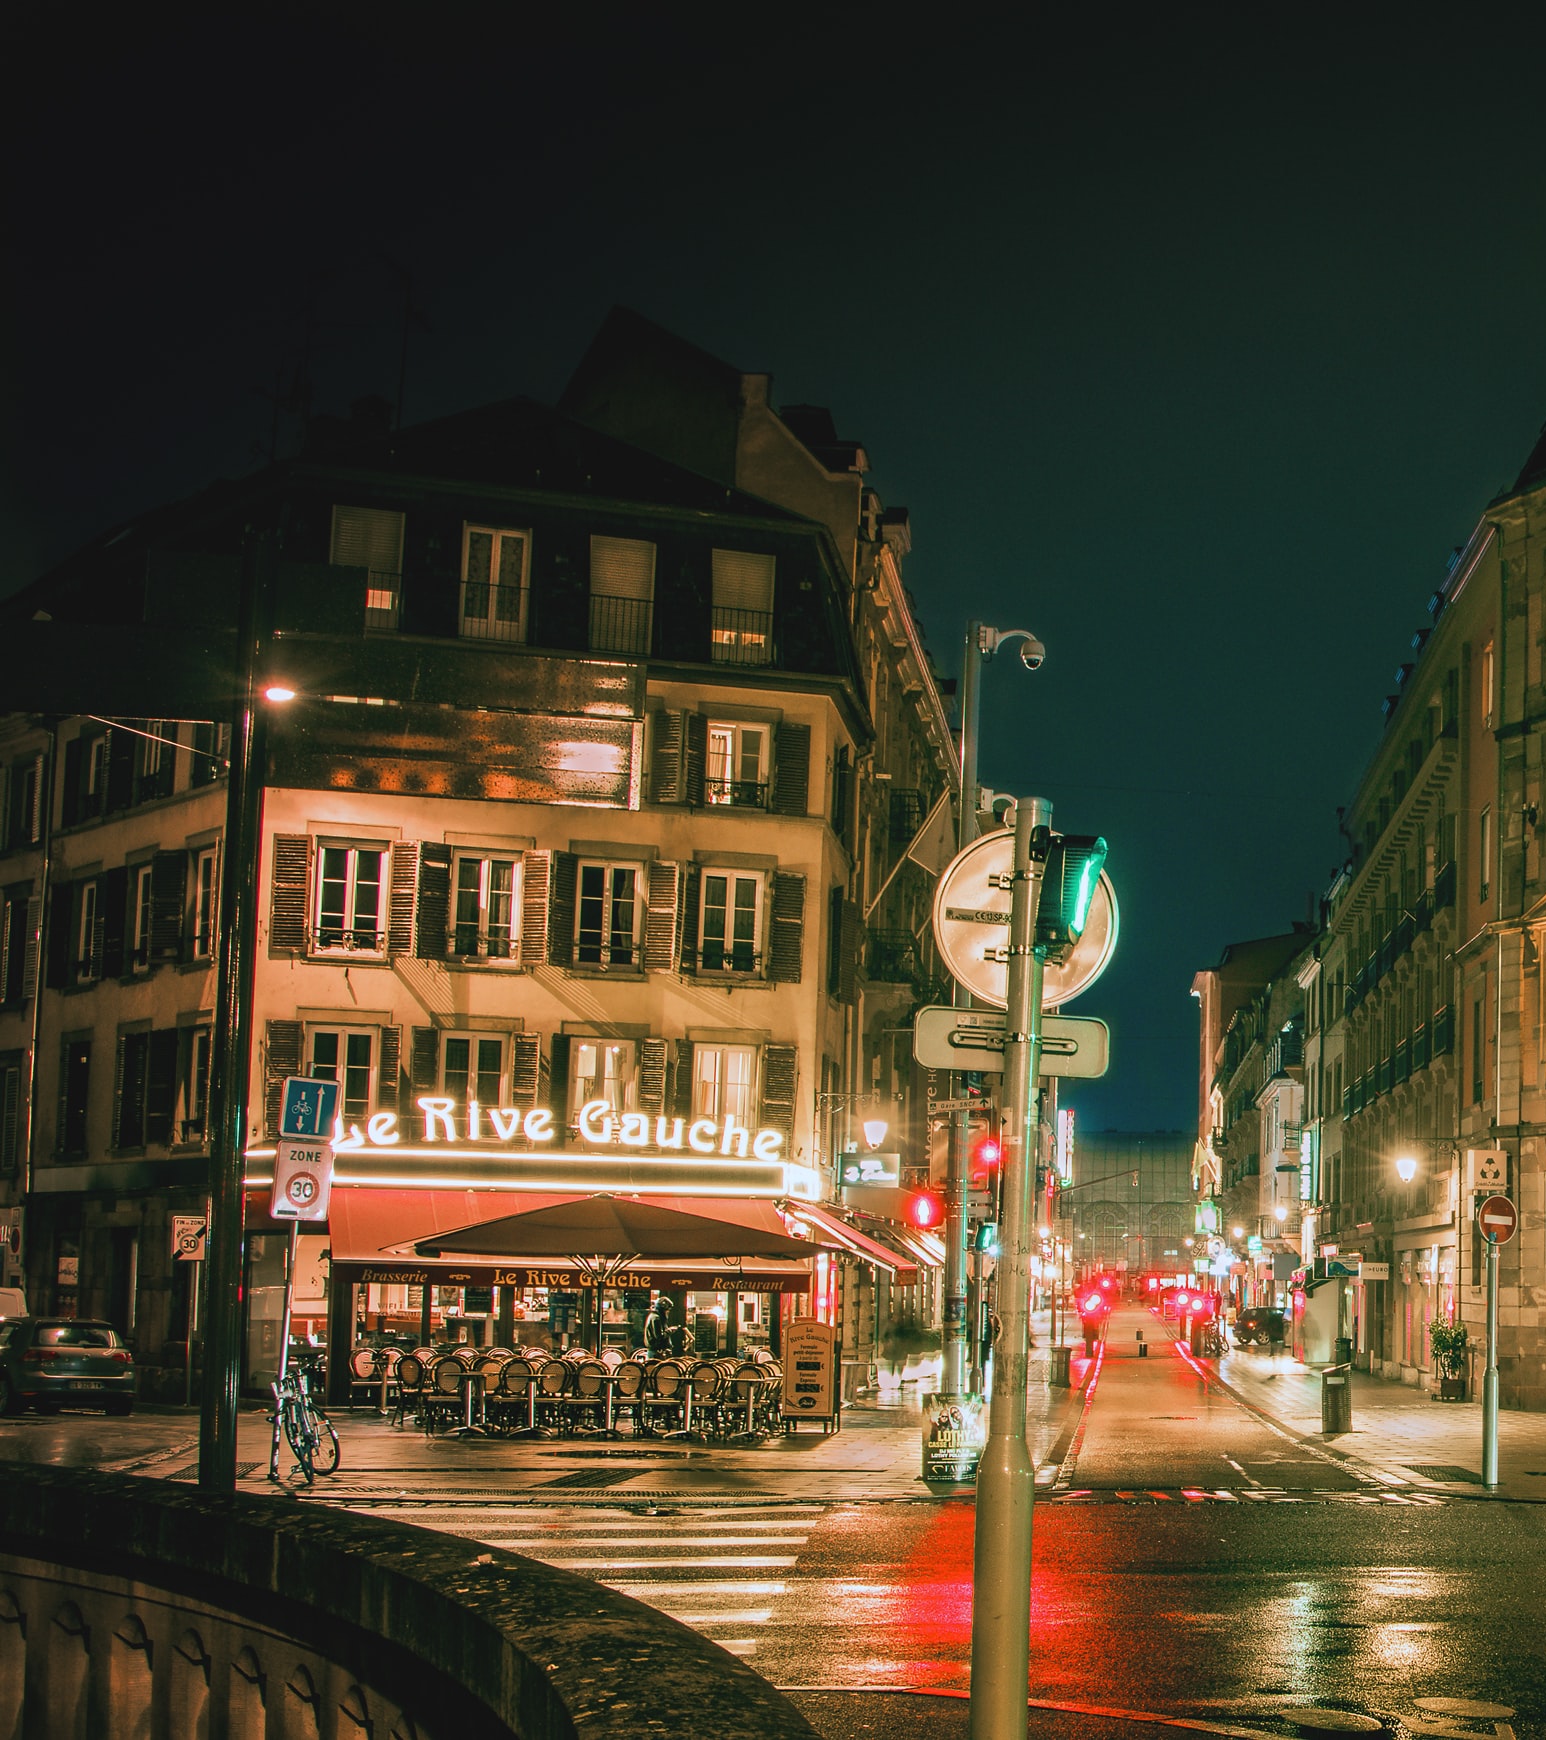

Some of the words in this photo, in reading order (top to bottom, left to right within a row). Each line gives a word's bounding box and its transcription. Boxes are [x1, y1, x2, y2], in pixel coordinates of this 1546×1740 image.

[329, 1107, 400, 1149] Le
[416, 1096, 555, 1142] Rive
[578, 1099, 784, 1162] Gauche
[289, 1150, 322, 1163] ZONE
[291, 1181, 314, 1199] 30
[183, 1239, 197, 1249] 30
[361, 1268, 428, 1283] Brasserie
[493, 1269, 517, 1285] Le
[526, 1270, 571, 1286] Rive
[711, 1277, 785, 1291] Restaurant
[938, 1430, 971, 1442] LOTHY
